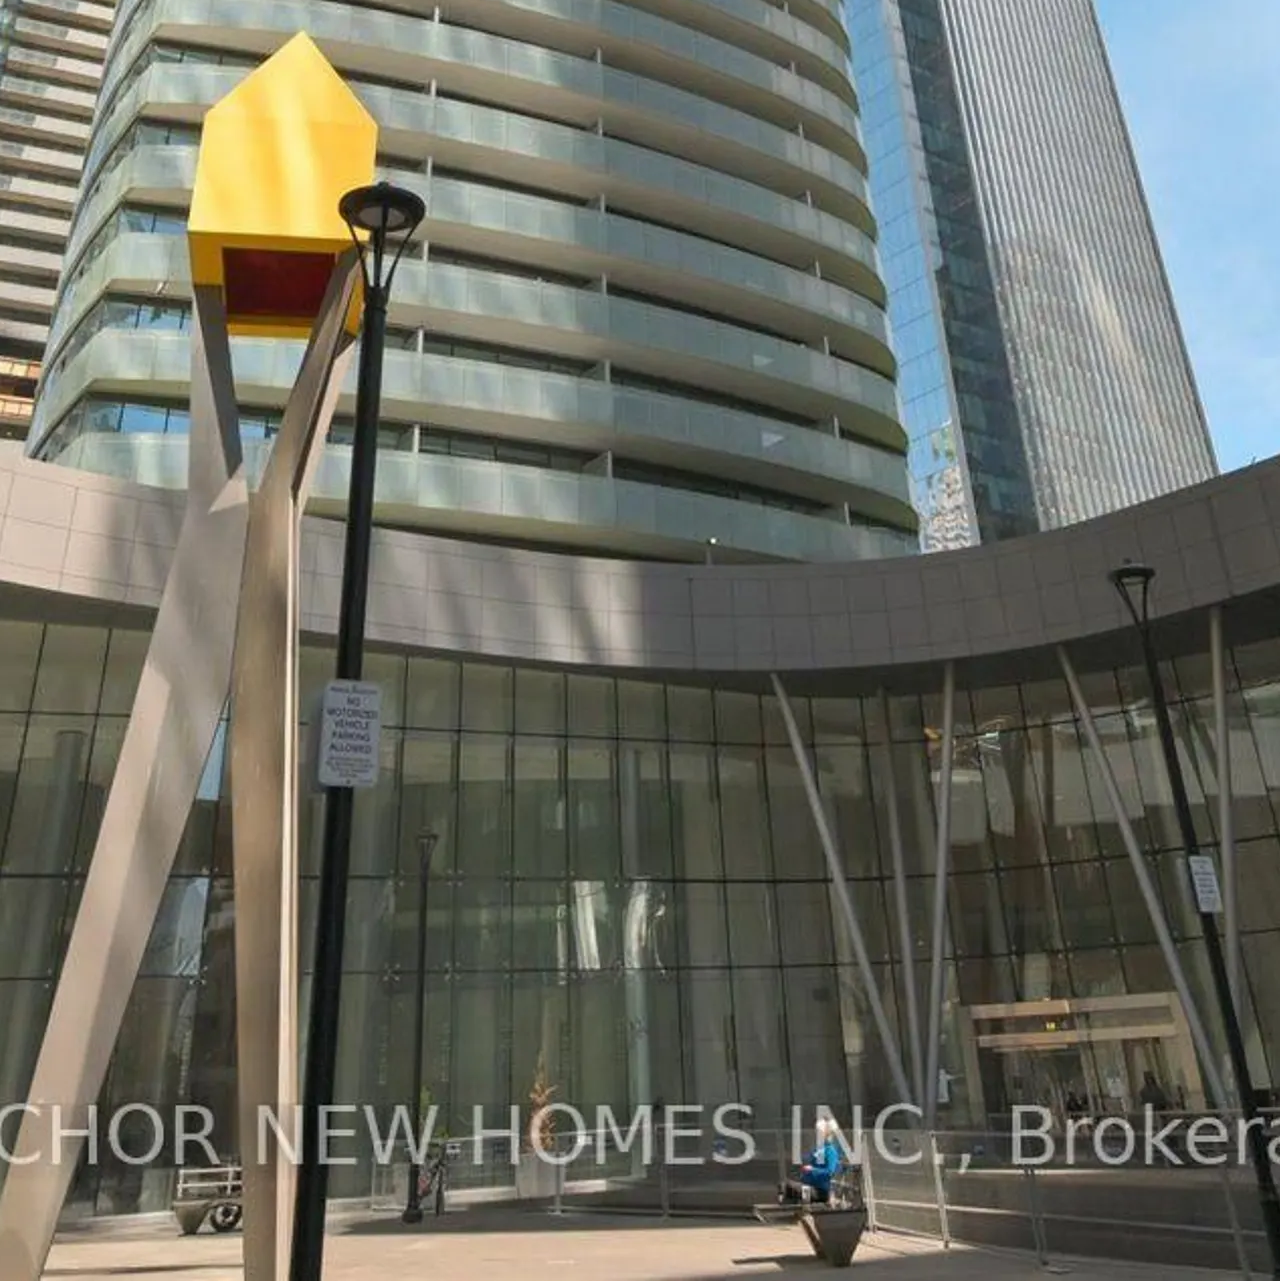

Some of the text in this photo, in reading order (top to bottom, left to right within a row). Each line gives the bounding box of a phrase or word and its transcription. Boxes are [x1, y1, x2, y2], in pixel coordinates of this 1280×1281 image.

[335, 719, 369, 730] VEHICLE
[332, 731, 370, 741] PARKING
[329, 743, 372, 754] ALLOWED
